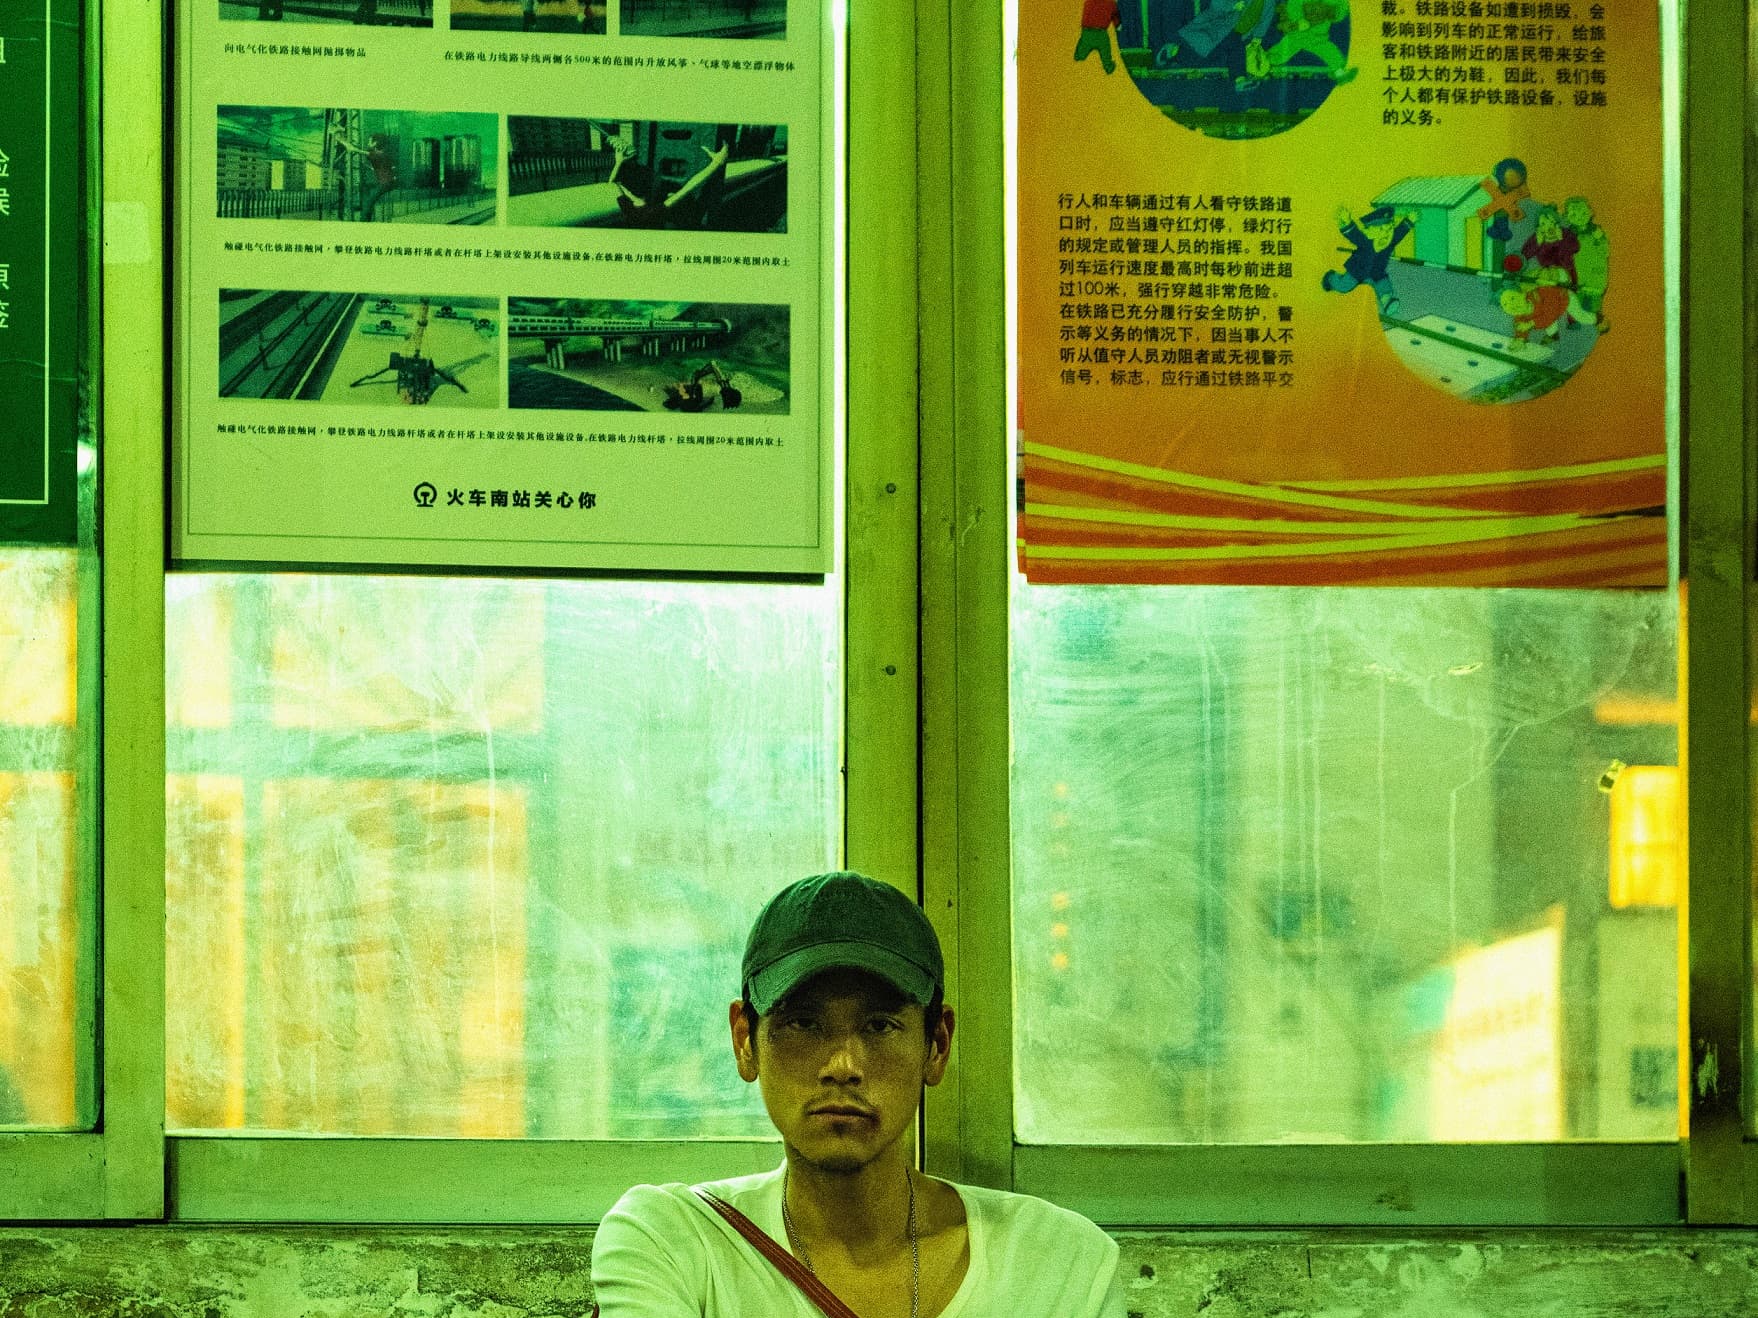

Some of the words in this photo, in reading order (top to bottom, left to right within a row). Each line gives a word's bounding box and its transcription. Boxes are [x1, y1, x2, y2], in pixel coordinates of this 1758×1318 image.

[1382, 42, 1606, 64] 客和铁路附近的居民带来安全
[1382, 108, 1442, 127] 的义务。
[1057, 192, 1293, 214] 行人和车辆通过有人看守铁路道
[1058, 237, 1293, 257] 的规定或管理人员的指挥。我国
[1059, 258, 1293, 279] 列车运行速度最高时每秒前进超
[1059, 346, 1294, 366] 听从值守人员劝阻者或无视警示
[446, 487, 597, 510] 火车南站关心你
